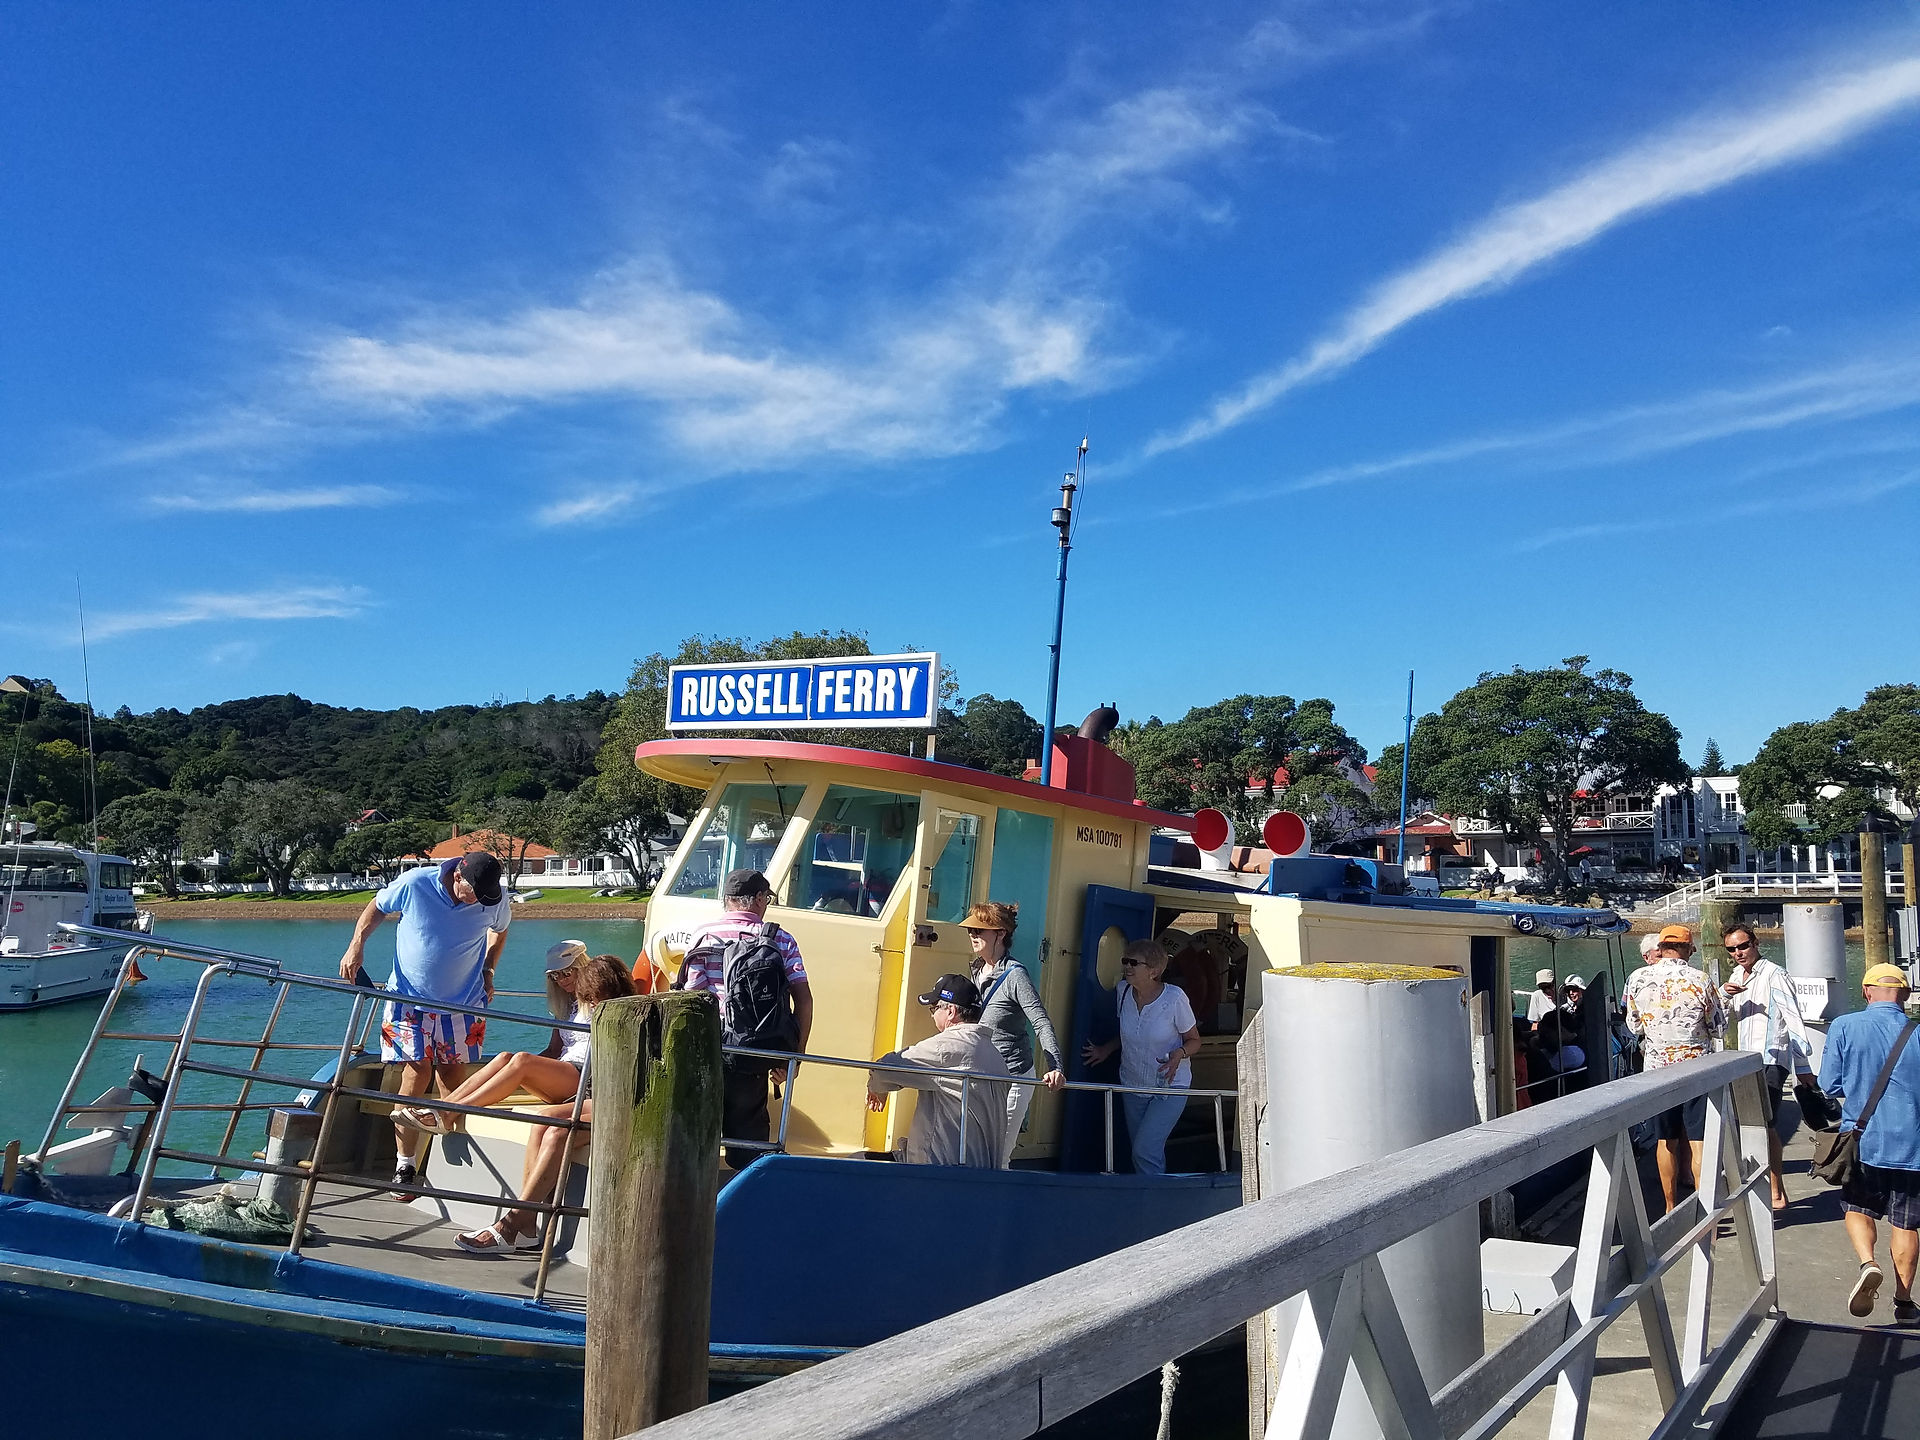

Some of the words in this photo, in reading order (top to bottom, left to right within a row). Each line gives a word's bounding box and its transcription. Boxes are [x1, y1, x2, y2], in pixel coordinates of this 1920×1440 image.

[681, 672, 803, 716] RUSSELL
[817, 666, 919, 713] FERRY
[1076, 825, 1094, 843] MSA
[1096, 829, 1122, 848] 100781
[1797, 984, 1825, 995] BERTH
